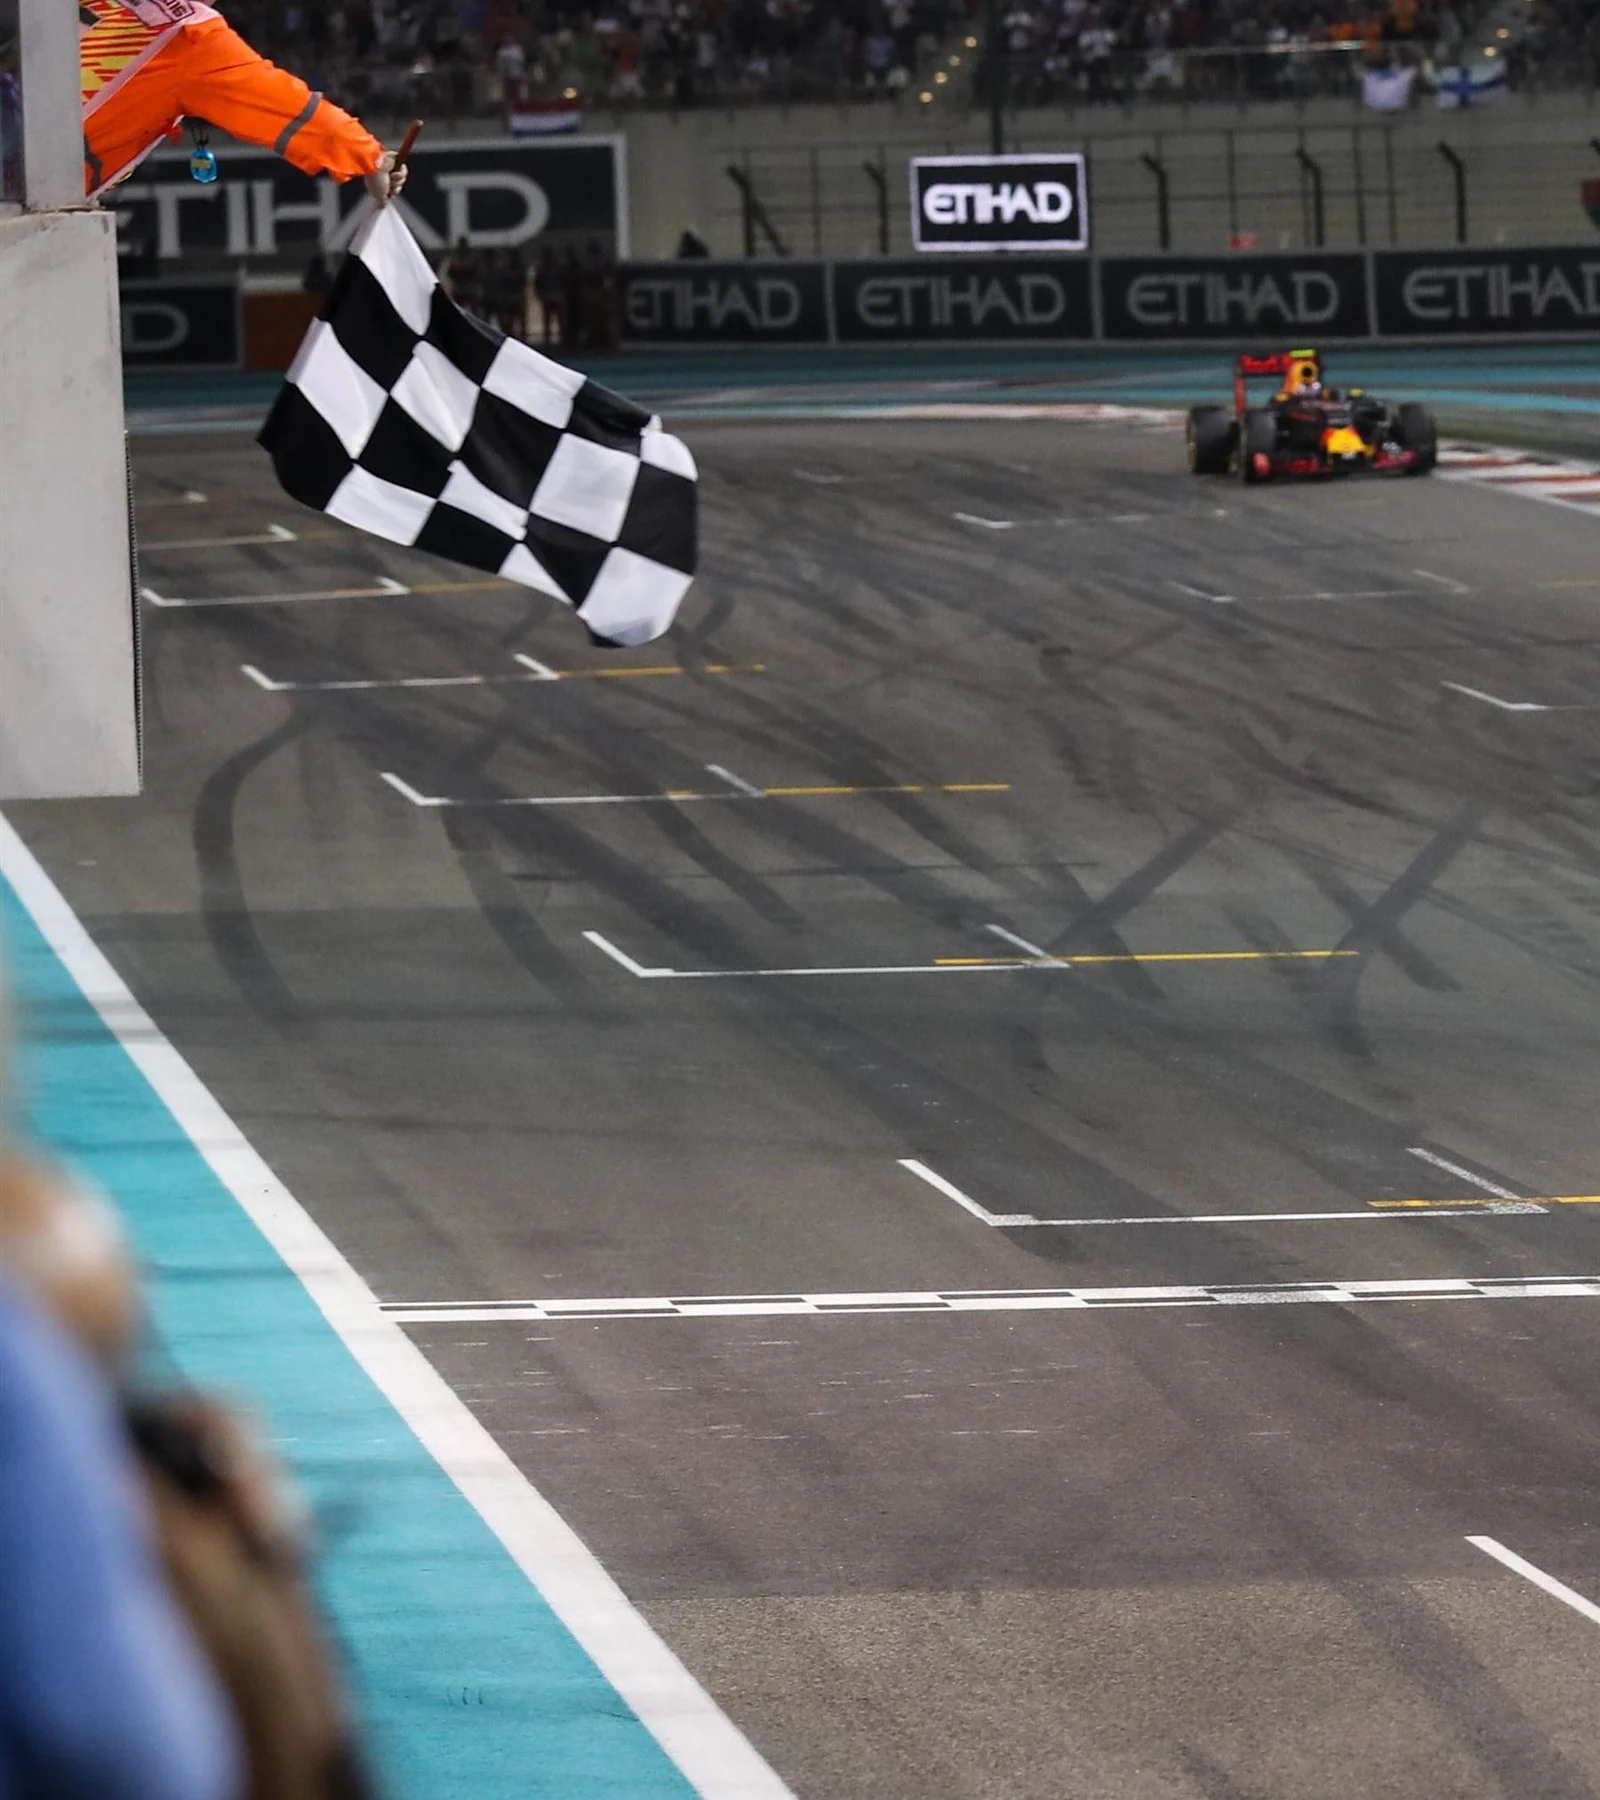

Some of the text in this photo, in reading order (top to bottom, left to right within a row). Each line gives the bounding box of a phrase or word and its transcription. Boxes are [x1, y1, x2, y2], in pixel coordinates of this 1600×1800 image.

[923, 181, 1073, 225] ETIHAD
[625, 278, 800, 330] ETIHAD
[856, 273, 1065, 328] ETIHAD
[1127, 270, 1339, 326] ETIHAD
